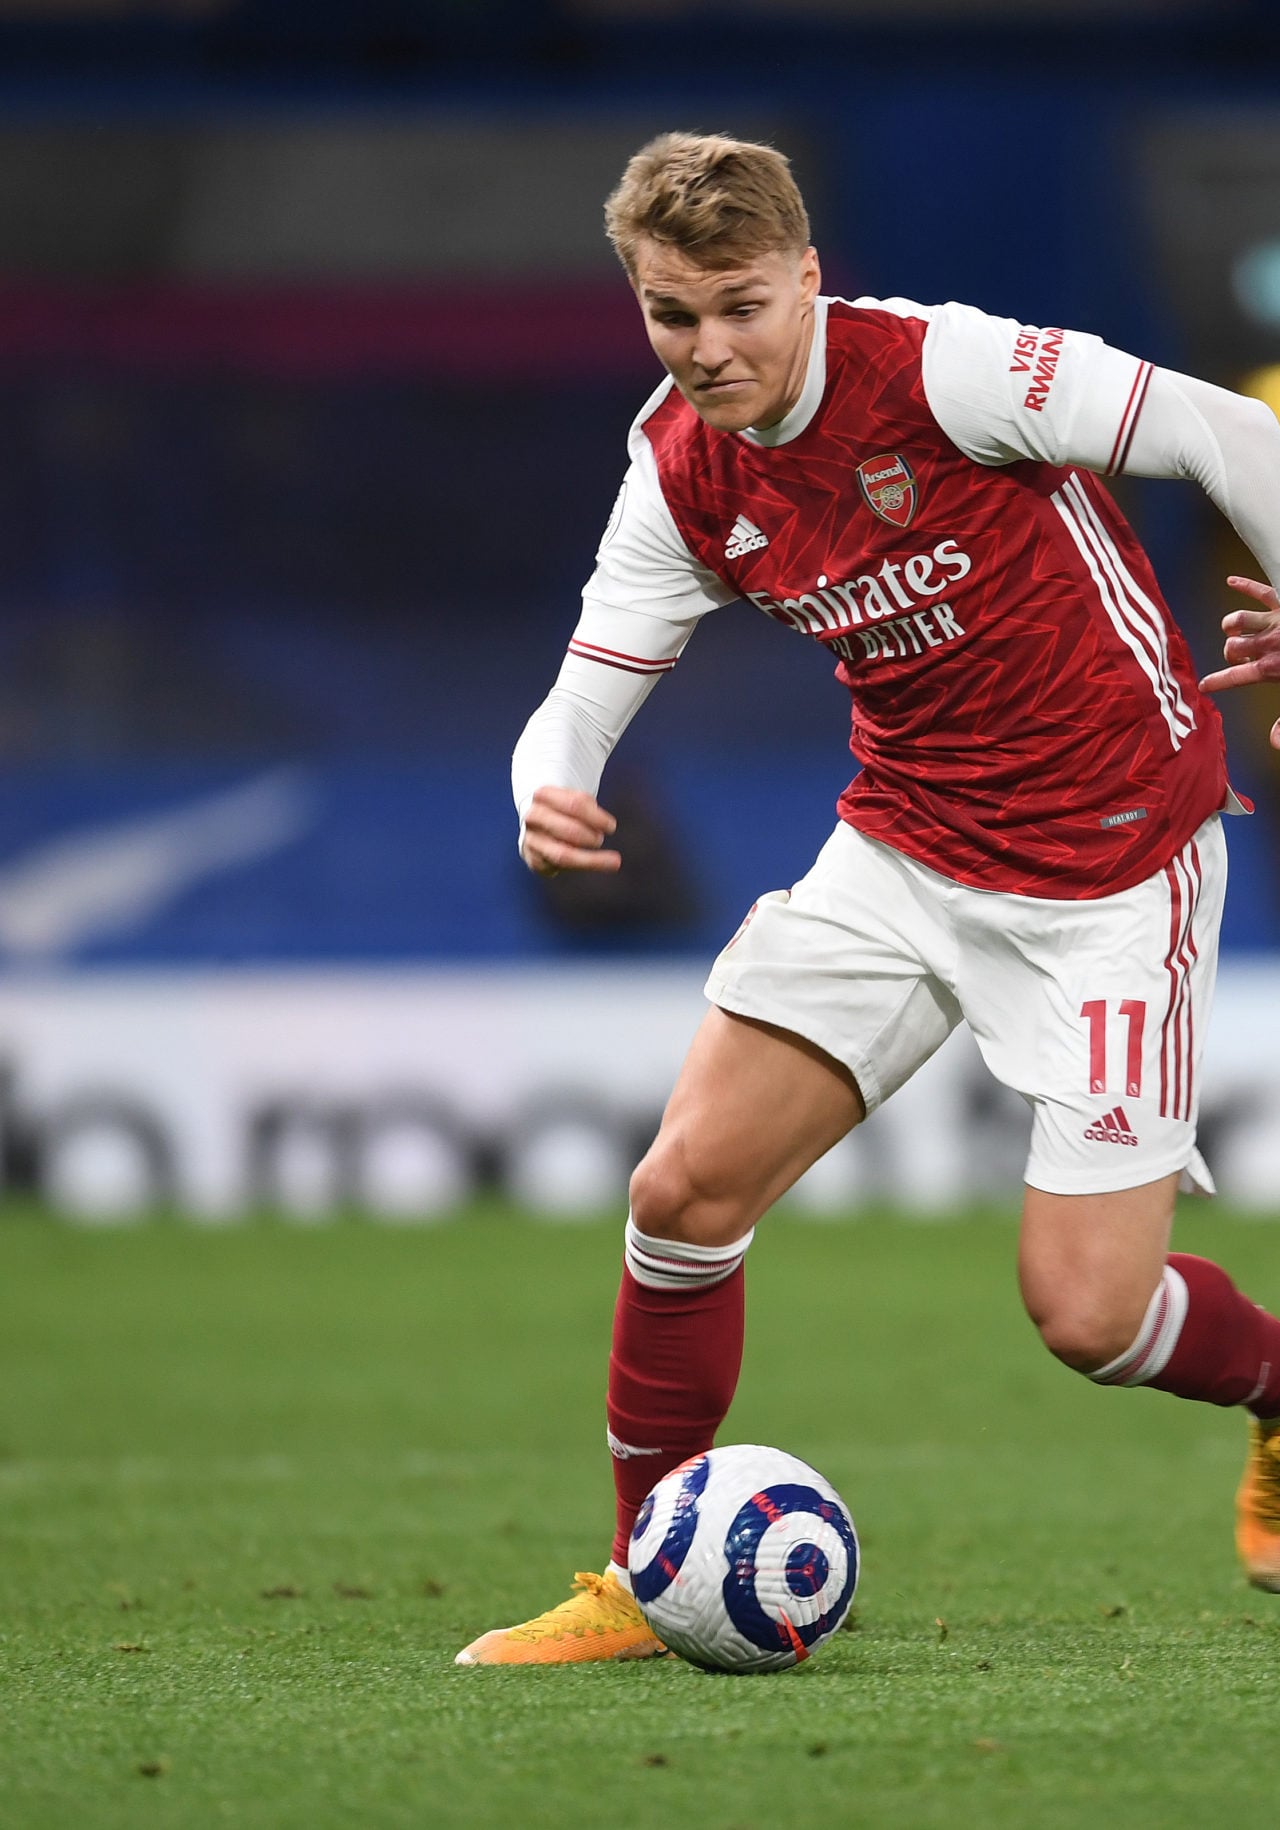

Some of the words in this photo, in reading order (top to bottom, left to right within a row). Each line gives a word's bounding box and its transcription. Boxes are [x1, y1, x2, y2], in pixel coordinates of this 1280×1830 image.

[1008, 329, 1040, 372] VISI
[864, 462, 904, 485] Arsenal
[746, 539, 972, 634] Emirates
[856, 602, 966, 660] BETTER
[1080, 999, 1147, 1098] 11
[1083, 1128, 1139, 1147] adidas
